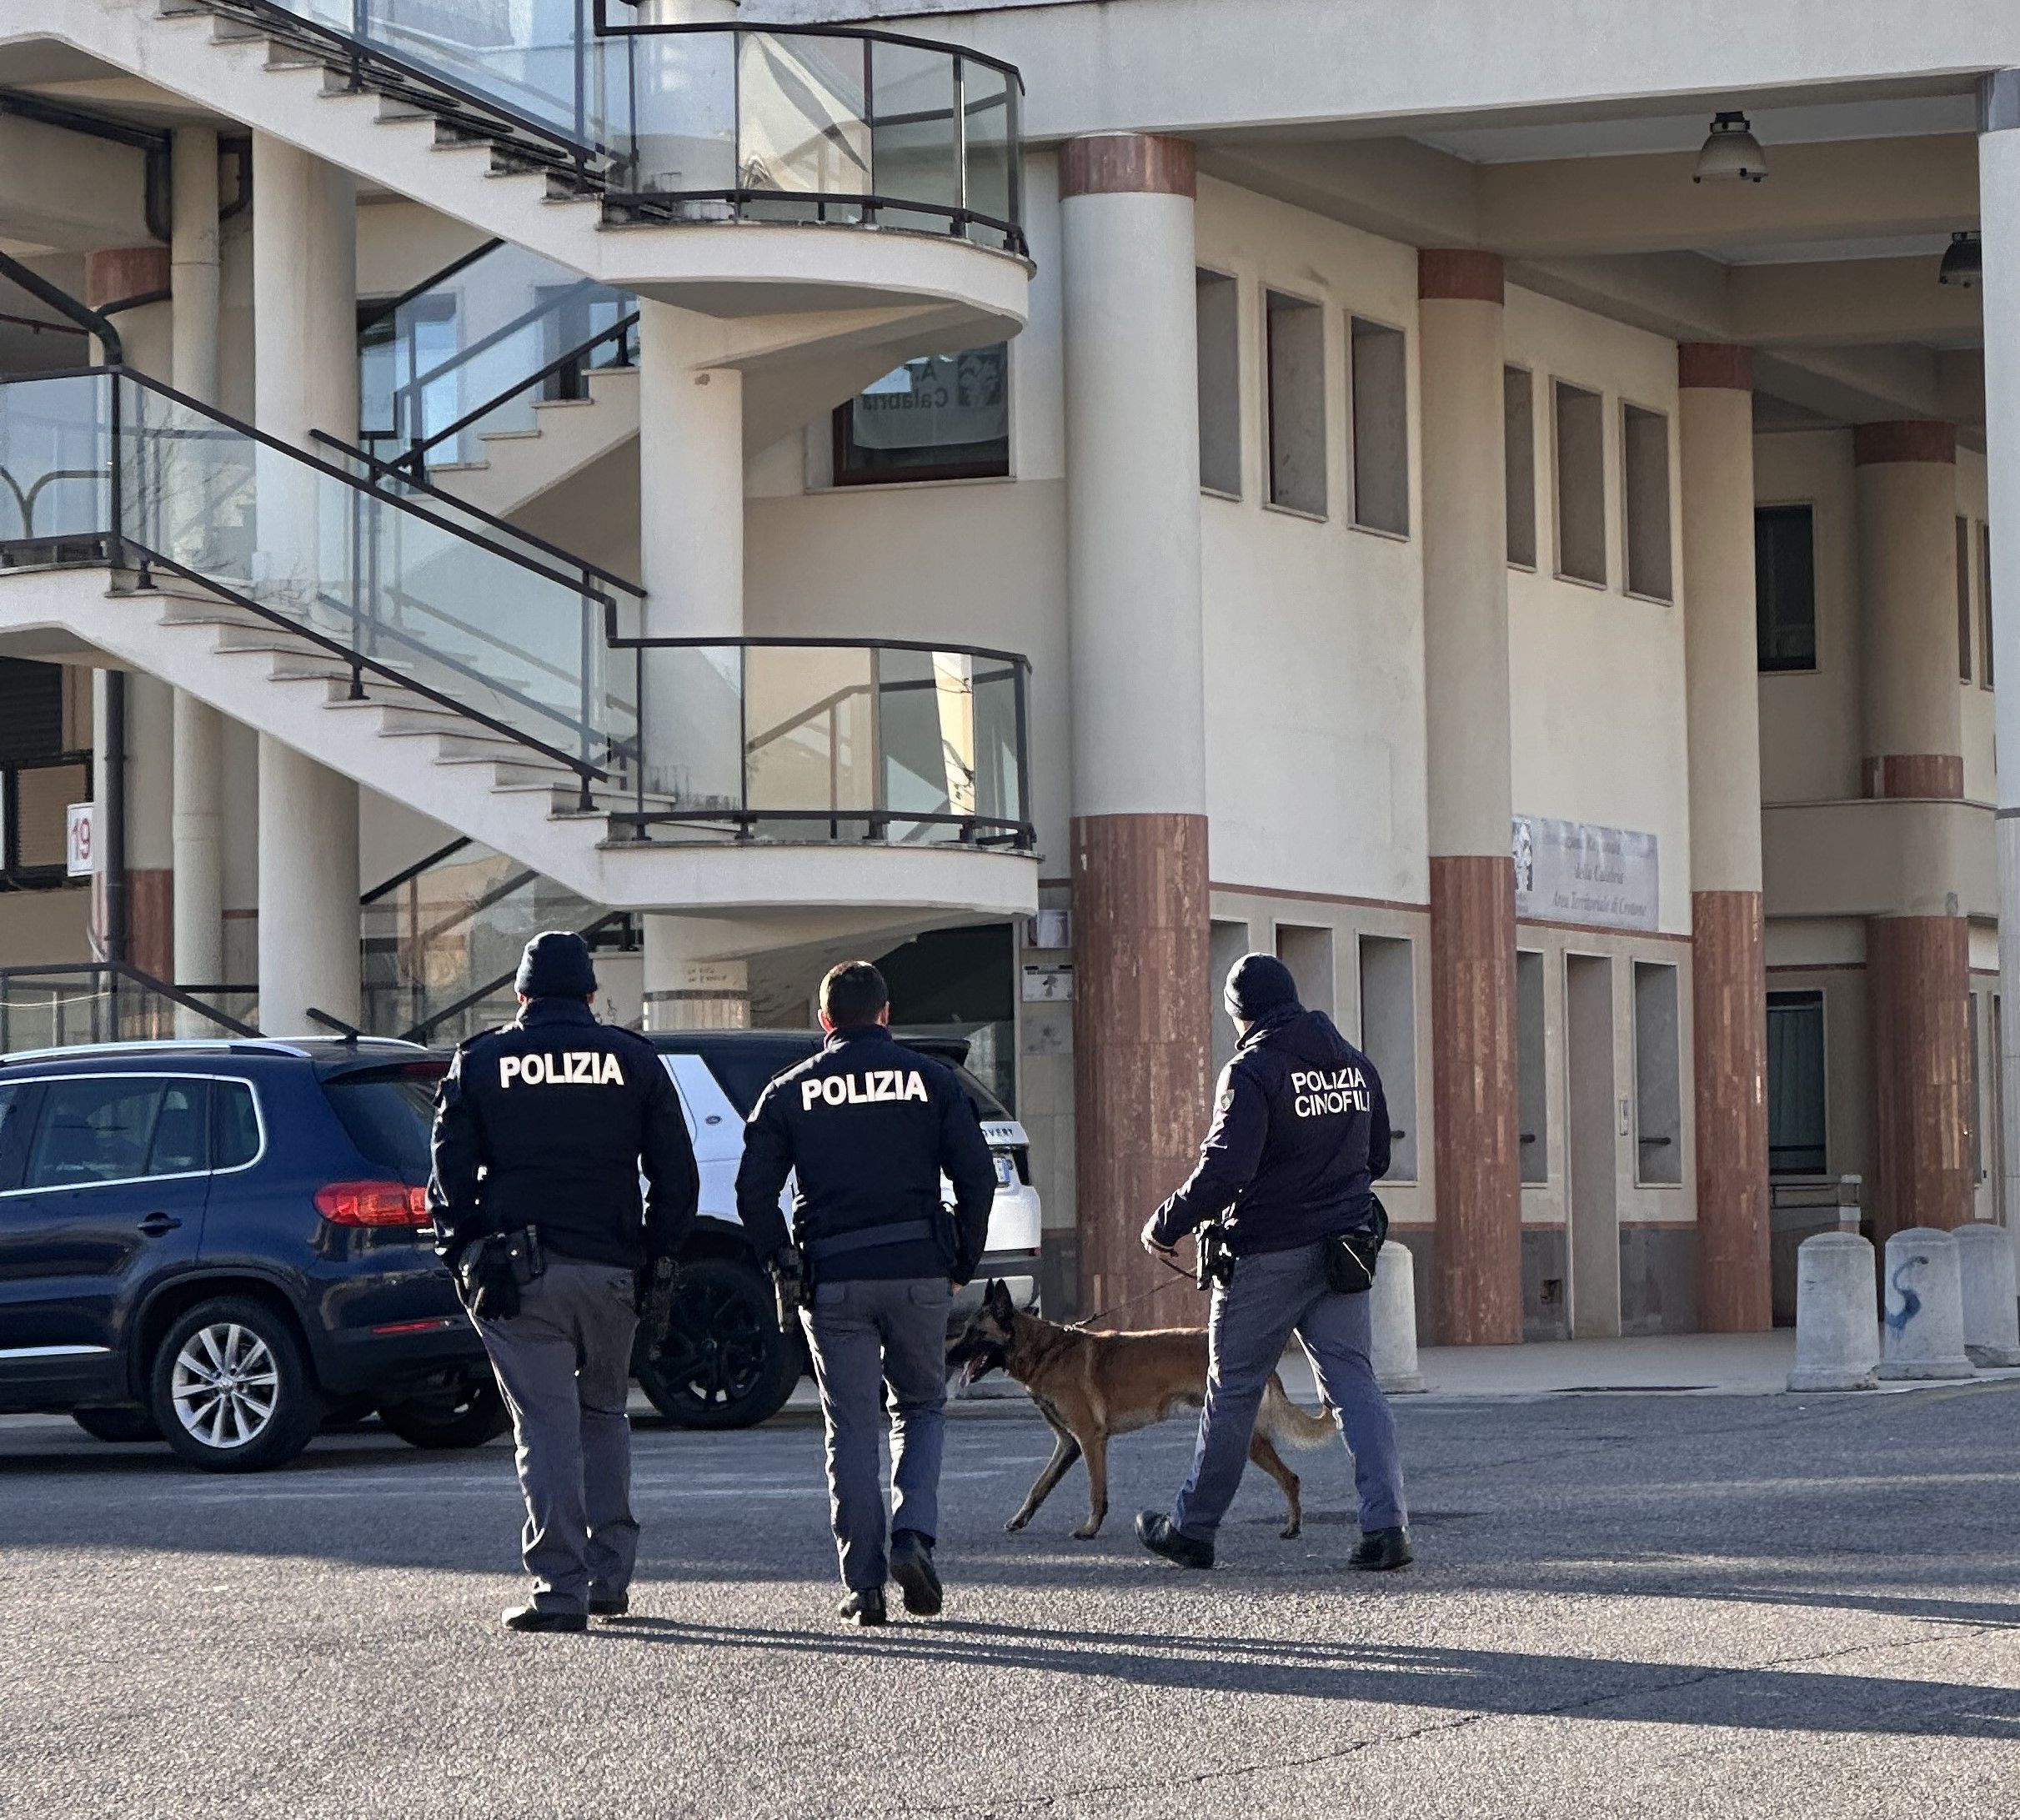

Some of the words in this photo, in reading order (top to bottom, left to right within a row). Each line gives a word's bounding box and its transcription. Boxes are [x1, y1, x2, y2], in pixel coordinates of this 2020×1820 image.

[73, 818, 91, 860] 19
[499, 1052, 624, 1087] POLIZIA
[1291, 1067, 1366, 1093] POLIZIA
[801, 1070, 928, 1111] POLIZIA
[1295, 1090, 1370, 1118] CINOFILI
